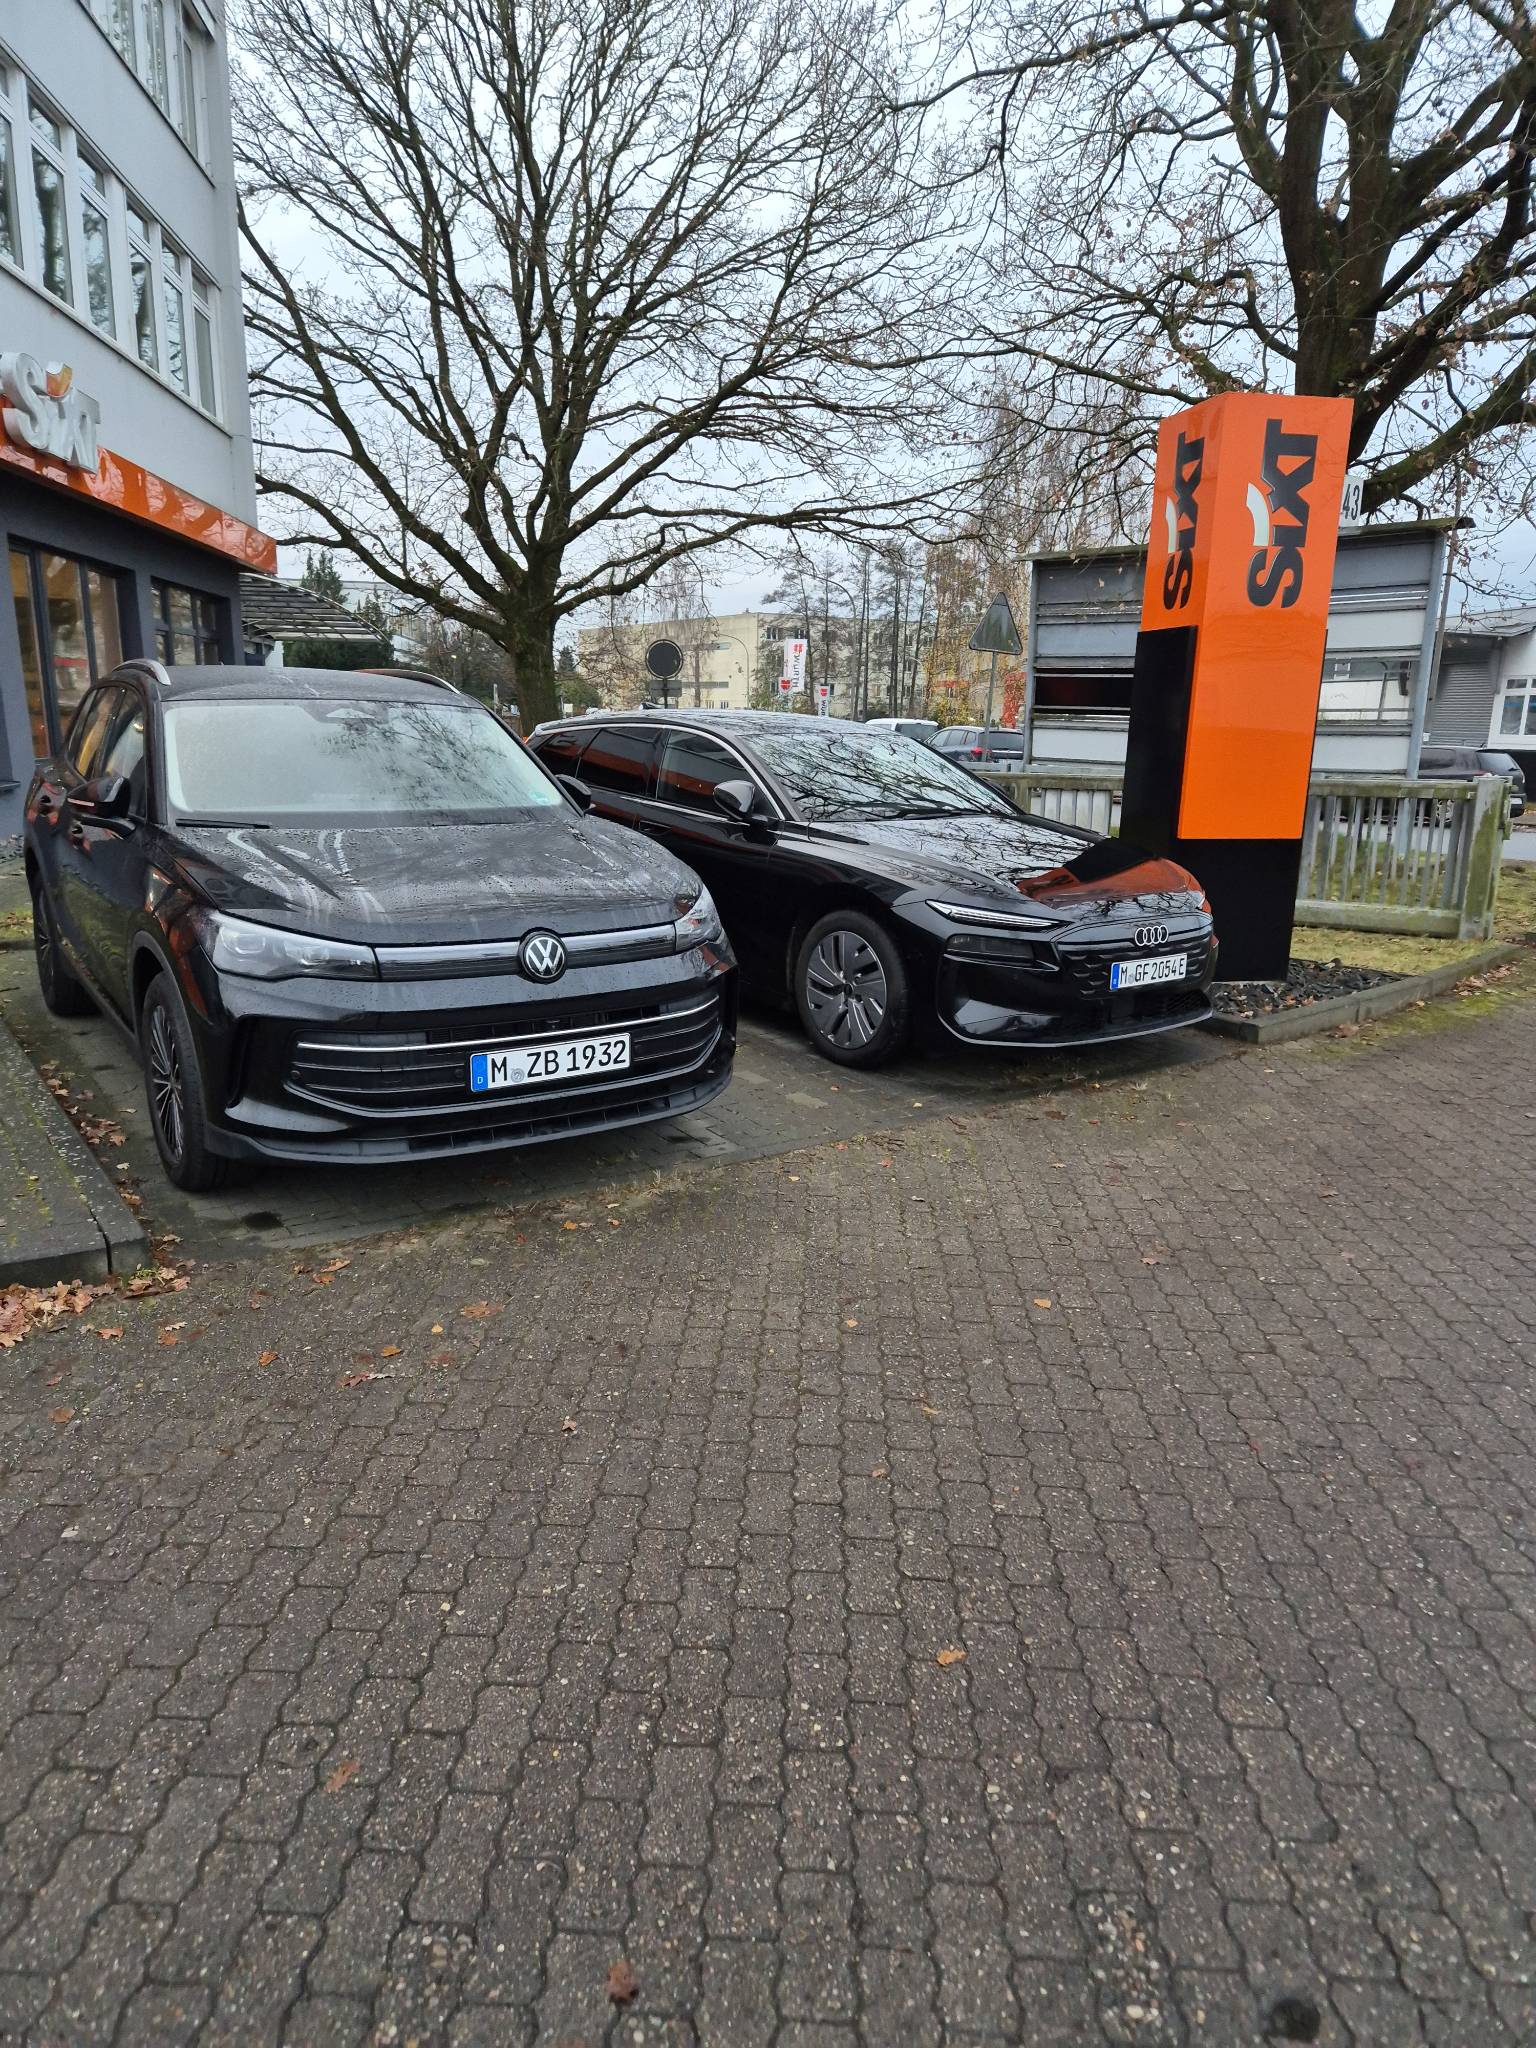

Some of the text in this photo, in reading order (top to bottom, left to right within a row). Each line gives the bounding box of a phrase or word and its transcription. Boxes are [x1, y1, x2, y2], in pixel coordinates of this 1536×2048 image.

[1246, 418, 1318, 608] SIXT
[1342, 483, 1360, 520] 43
[526, 937, 565, 977] VW
[1120, 965, 1128, 984] M
[1134, 963, 1149, 982] GF
[491, 1056, 508, 1083] M
[527, 1050, 560, 1078] ZB
[567, 1040, 626, 1072] 1932
